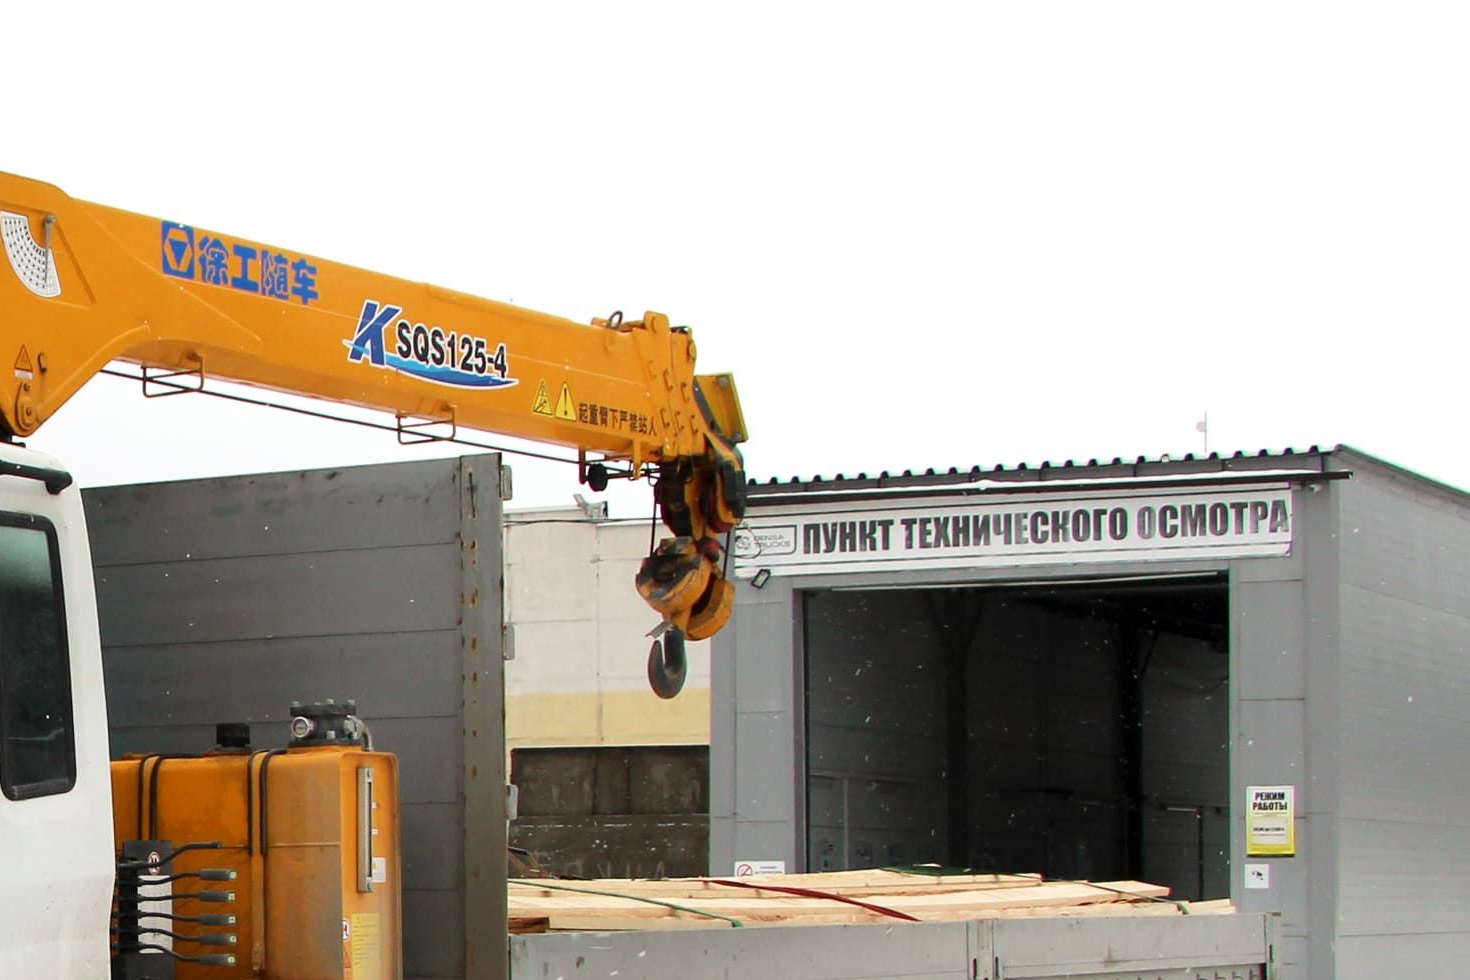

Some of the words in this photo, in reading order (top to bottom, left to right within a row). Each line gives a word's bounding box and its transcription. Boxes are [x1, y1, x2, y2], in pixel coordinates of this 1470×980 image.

[199, 235, 319, 305] 徐工随车
[348, 300, 402, 368] K
[396, 321, 508, 379] SQS125-4
[803, 519, 894, 554] ПУНКТ
[901, 506, 1128, 549] ТЕХНИЧЕСКОГО
[1136, 499, 1290, 540] ОСМОТРА
[1253, 802, 1287, 811] РАБОТЫ
[1255, 792, 1285, 801] РЕЖИМ
